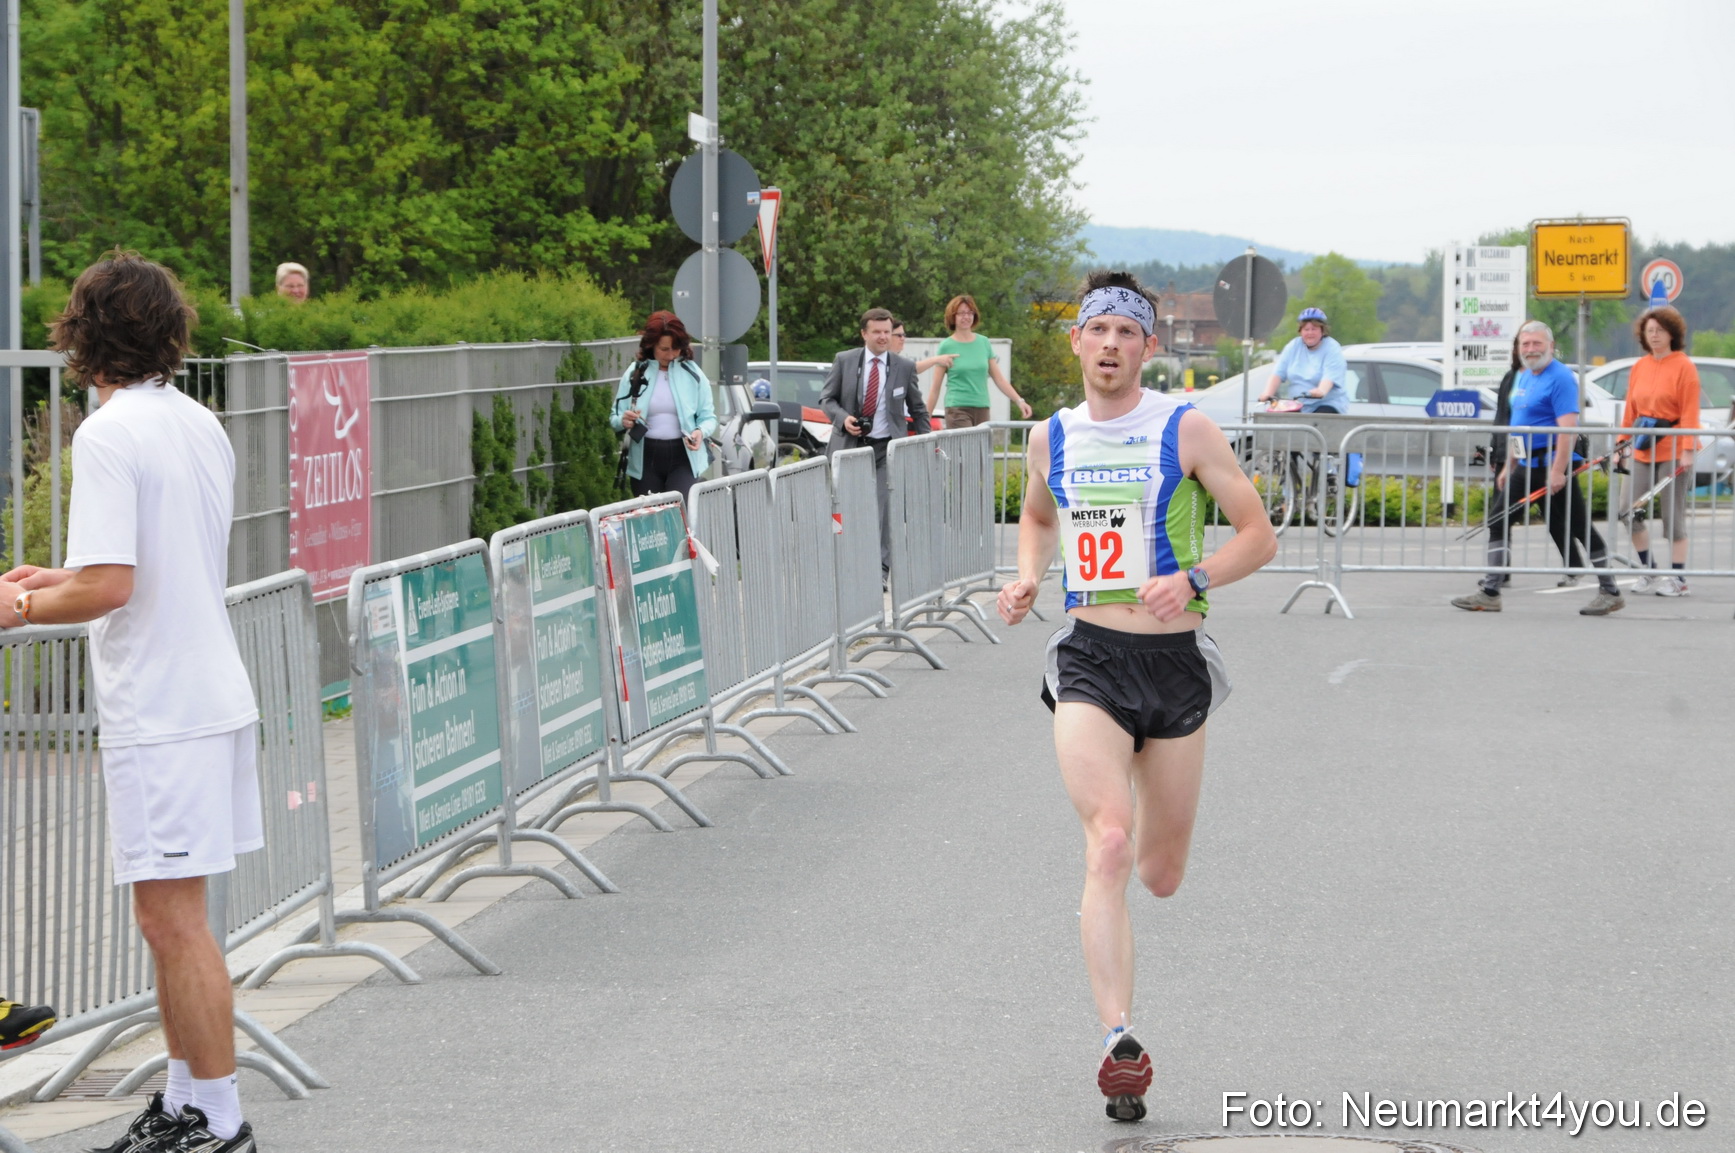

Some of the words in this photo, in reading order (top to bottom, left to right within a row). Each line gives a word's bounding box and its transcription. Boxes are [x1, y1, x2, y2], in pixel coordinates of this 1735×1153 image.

[1569, 235, 1595, 244] Nach
[1544, 248, 1619, 266] Neumarkt
[1569, 272, 1575, 281] 5
[1583, 273, 1596, 281] km
[1436, 401, 1475, 417] VOLVO
[303, 447, 363, 509] ZEITLOS
[1071, 466, 1153, 484] BOCK
[1071, 510, 1107, 521] MEYER
[1072, 519, 1109, 528] WERBUNG
[1078, 530, 1125, 582] 92
[536, 628, 549, 661] Fun
[411, 677, 426, 714] Fun
[426, 671, 435, 709] &
[434, 664, 457, 706] Action
[457, 659, 467, 696] in
[415, 727, 444, 770] sicheren
[445, 709, 476, 755] Bahnen!
